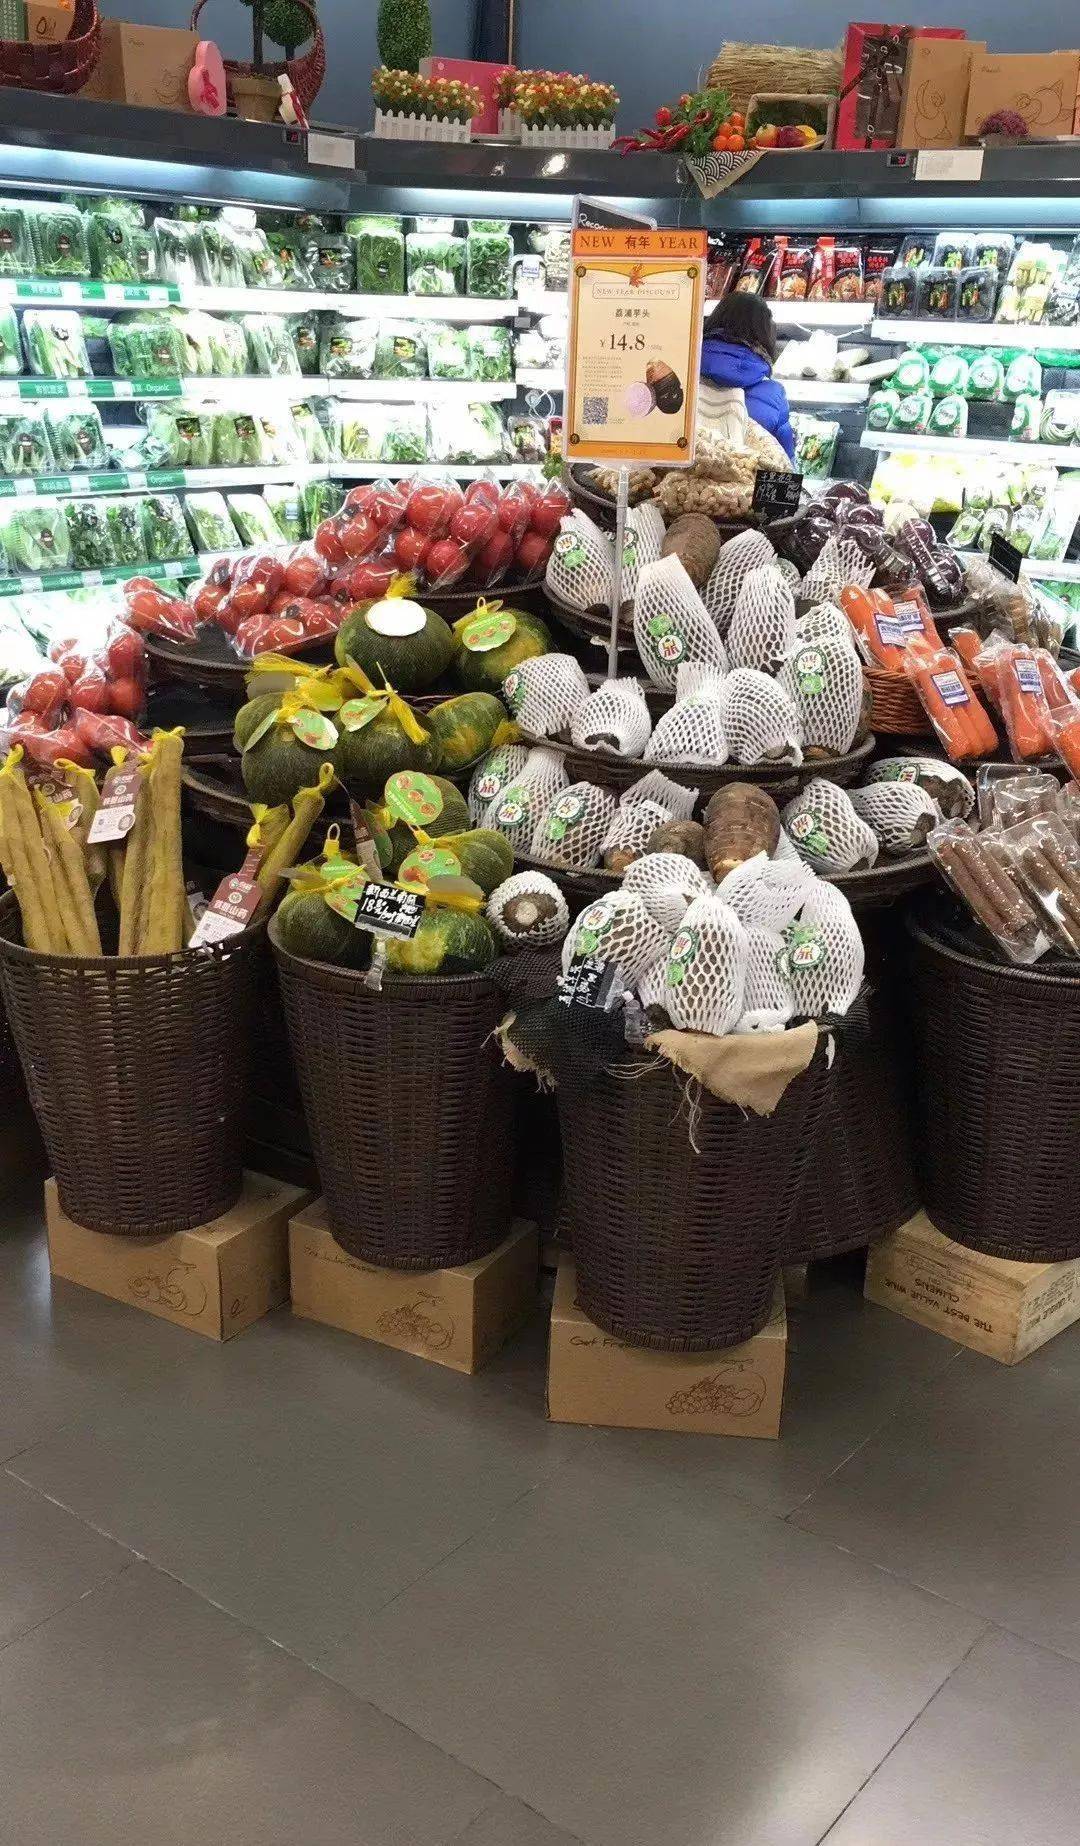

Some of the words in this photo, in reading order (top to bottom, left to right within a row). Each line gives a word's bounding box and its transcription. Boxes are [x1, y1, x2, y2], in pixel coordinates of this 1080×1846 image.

[580, 236, 615, 248] NEW
[625, 235, 651, 250] 有年
[659, 236, 698, 249] YEAR
[597, 288, 614, 296] NEW
[616, 288, 634, 296] YEAR
[637, 288, 676, 296] DISCOUNT
[610, 333, 646, 351] 14.8
[911, 1291, 940, 1307] VALUE
[943, 1306, 970, 1323] BEST
[973, 1317, 994, 1334] THE
